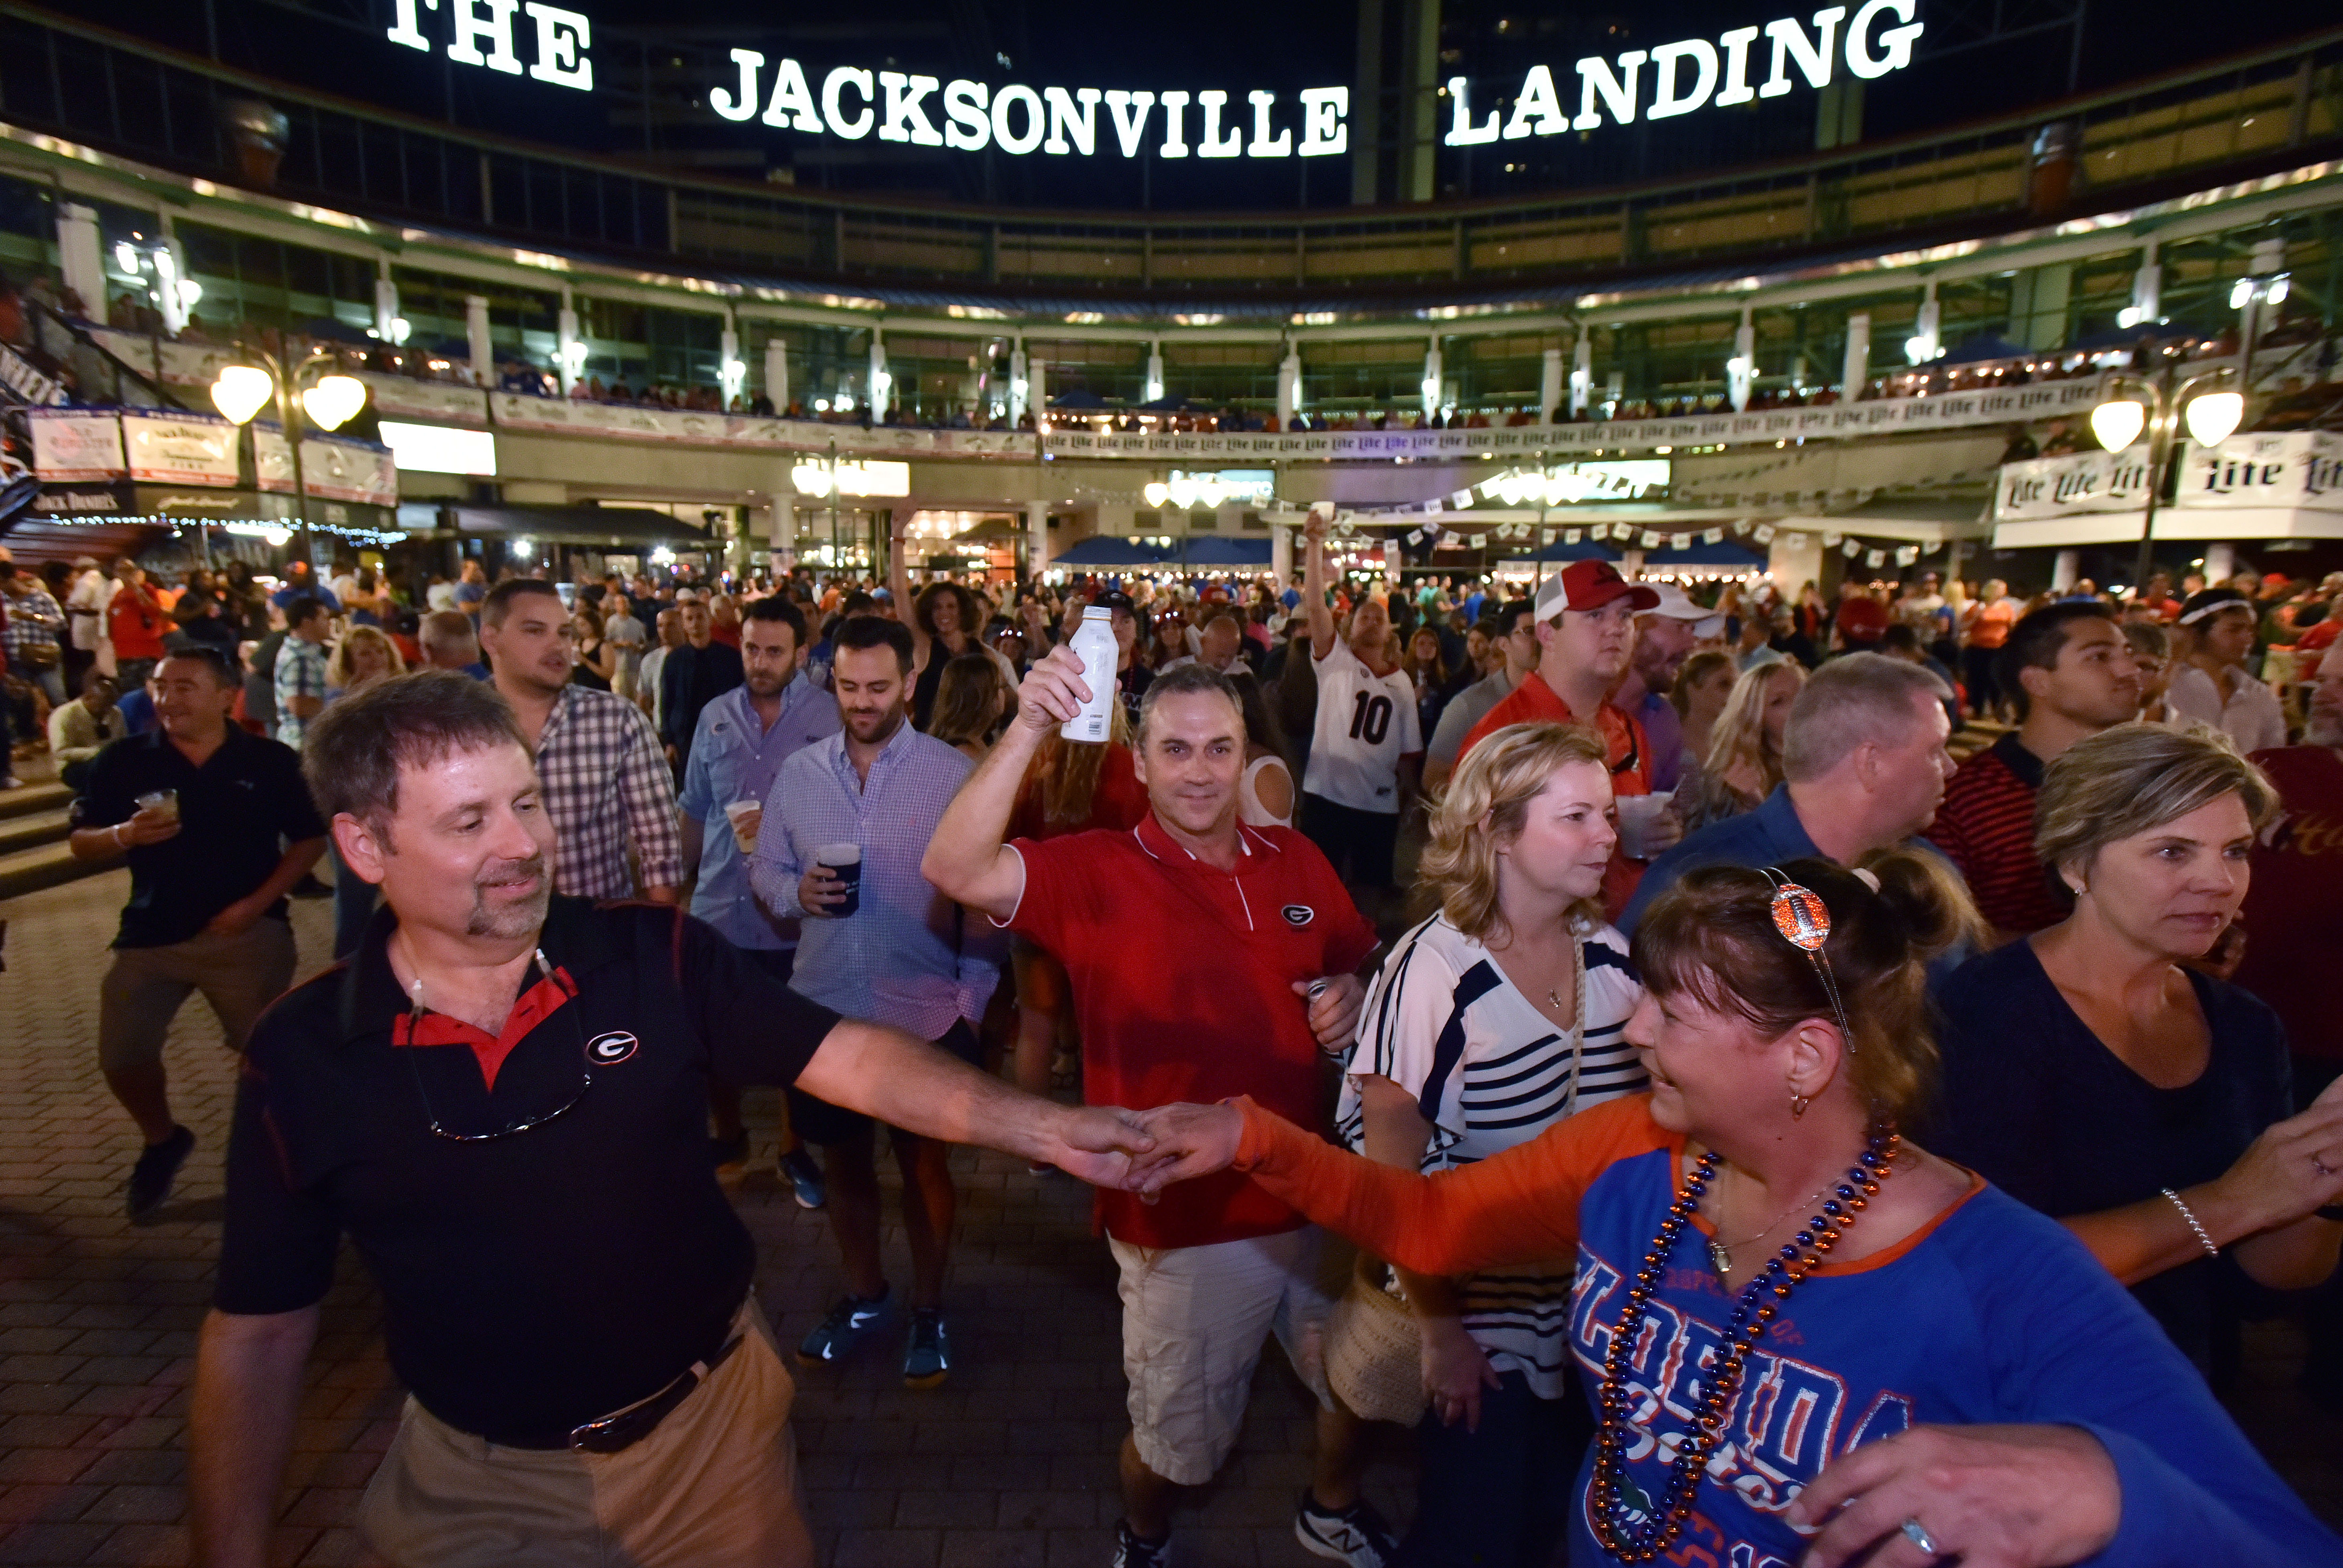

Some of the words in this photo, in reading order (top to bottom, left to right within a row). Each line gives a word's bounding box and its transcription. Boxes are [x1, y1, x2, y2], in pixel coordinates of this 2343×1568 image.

[388, 0, 593, 91] THE
[710, 48, 1348, 158] JACKSONVILLE
[1445, 0, 1924, 145] LANDING
[2107, 465, 2145, 498] Lit
[2205, 460, 2283, 493] Lite
[2305, 455, 2343, 494] Lit
[1349, 689, 1393, 745] 10
